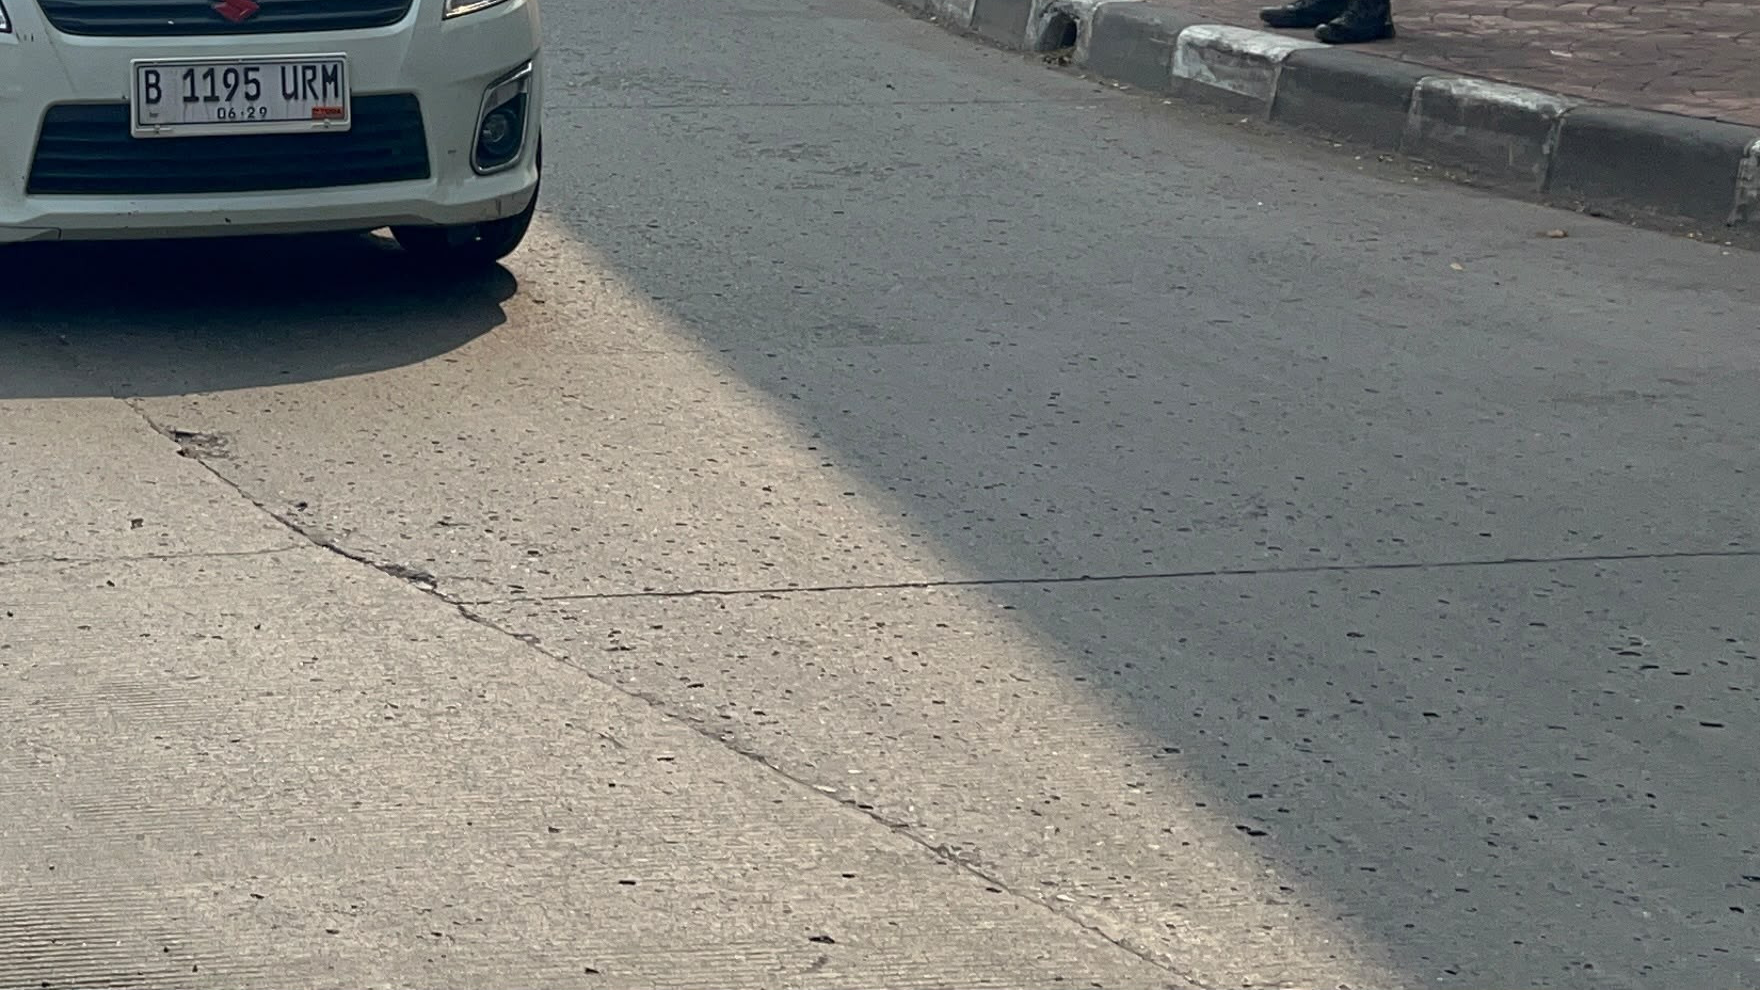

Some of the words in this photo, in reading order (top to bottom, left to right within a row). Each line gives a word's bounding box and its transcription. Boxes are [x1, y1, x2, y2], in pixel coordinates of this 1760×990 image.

[145, 70, 162, 104] B
[183, 67, 261, 102] 1195
[281, 64, 339, 100] URM
